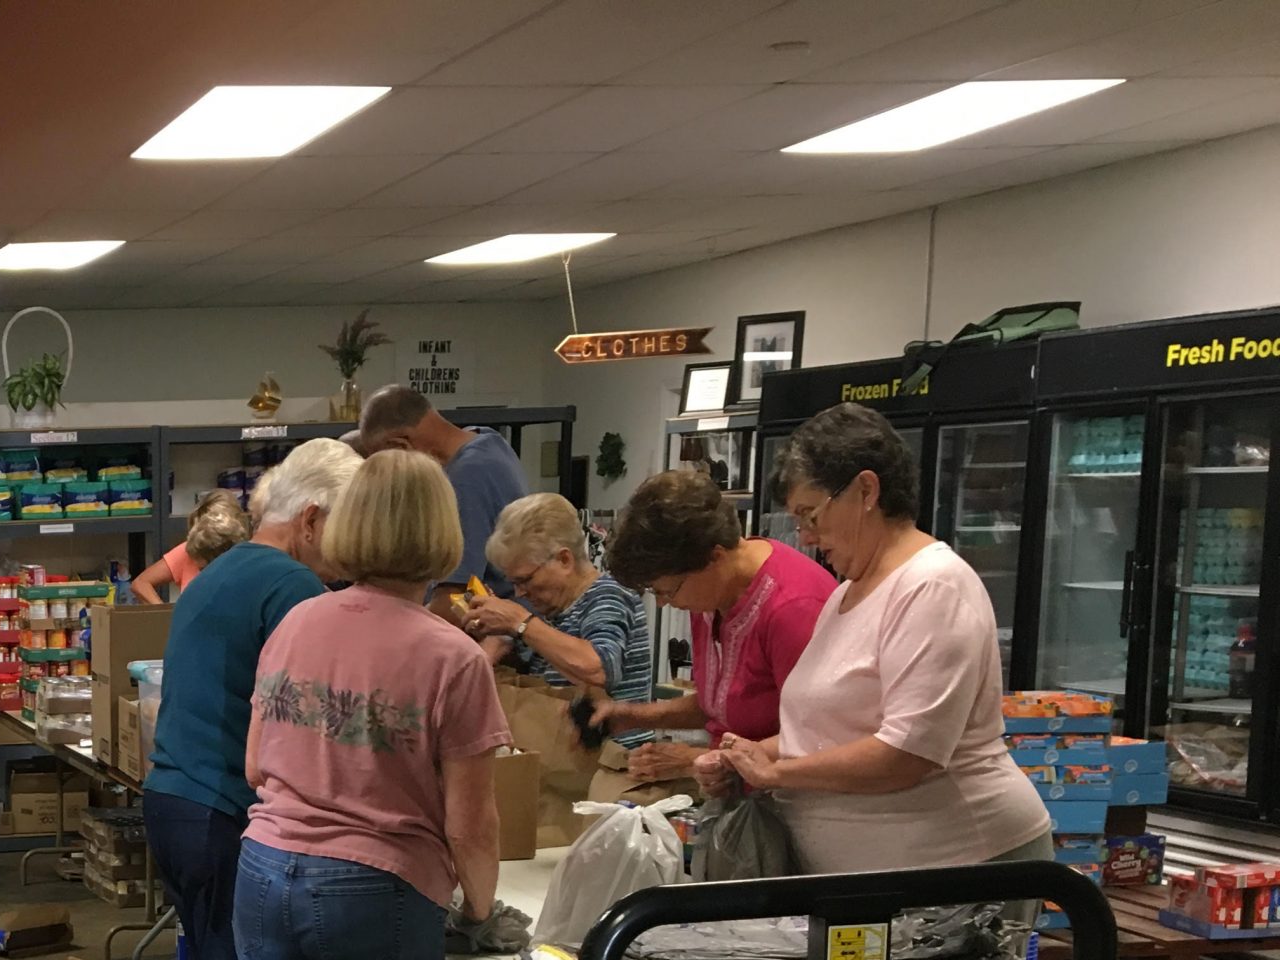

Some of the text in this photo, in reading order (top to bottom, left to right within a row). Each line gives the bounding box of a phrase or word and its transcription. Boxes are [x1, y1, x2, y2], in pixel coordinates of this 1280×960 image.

[419, 340, 452, 354] INFANT
[582, 335, 688, 358] CLOTHES
[1166, 339, 1225, 368] Fresh
[431, 354, 438, 367] &
[409, 368, 461, 381] CHILDRENS
[411, 381, 457, 394] CLOTHING
[841, 375, 930, 402] Frozen Fd
